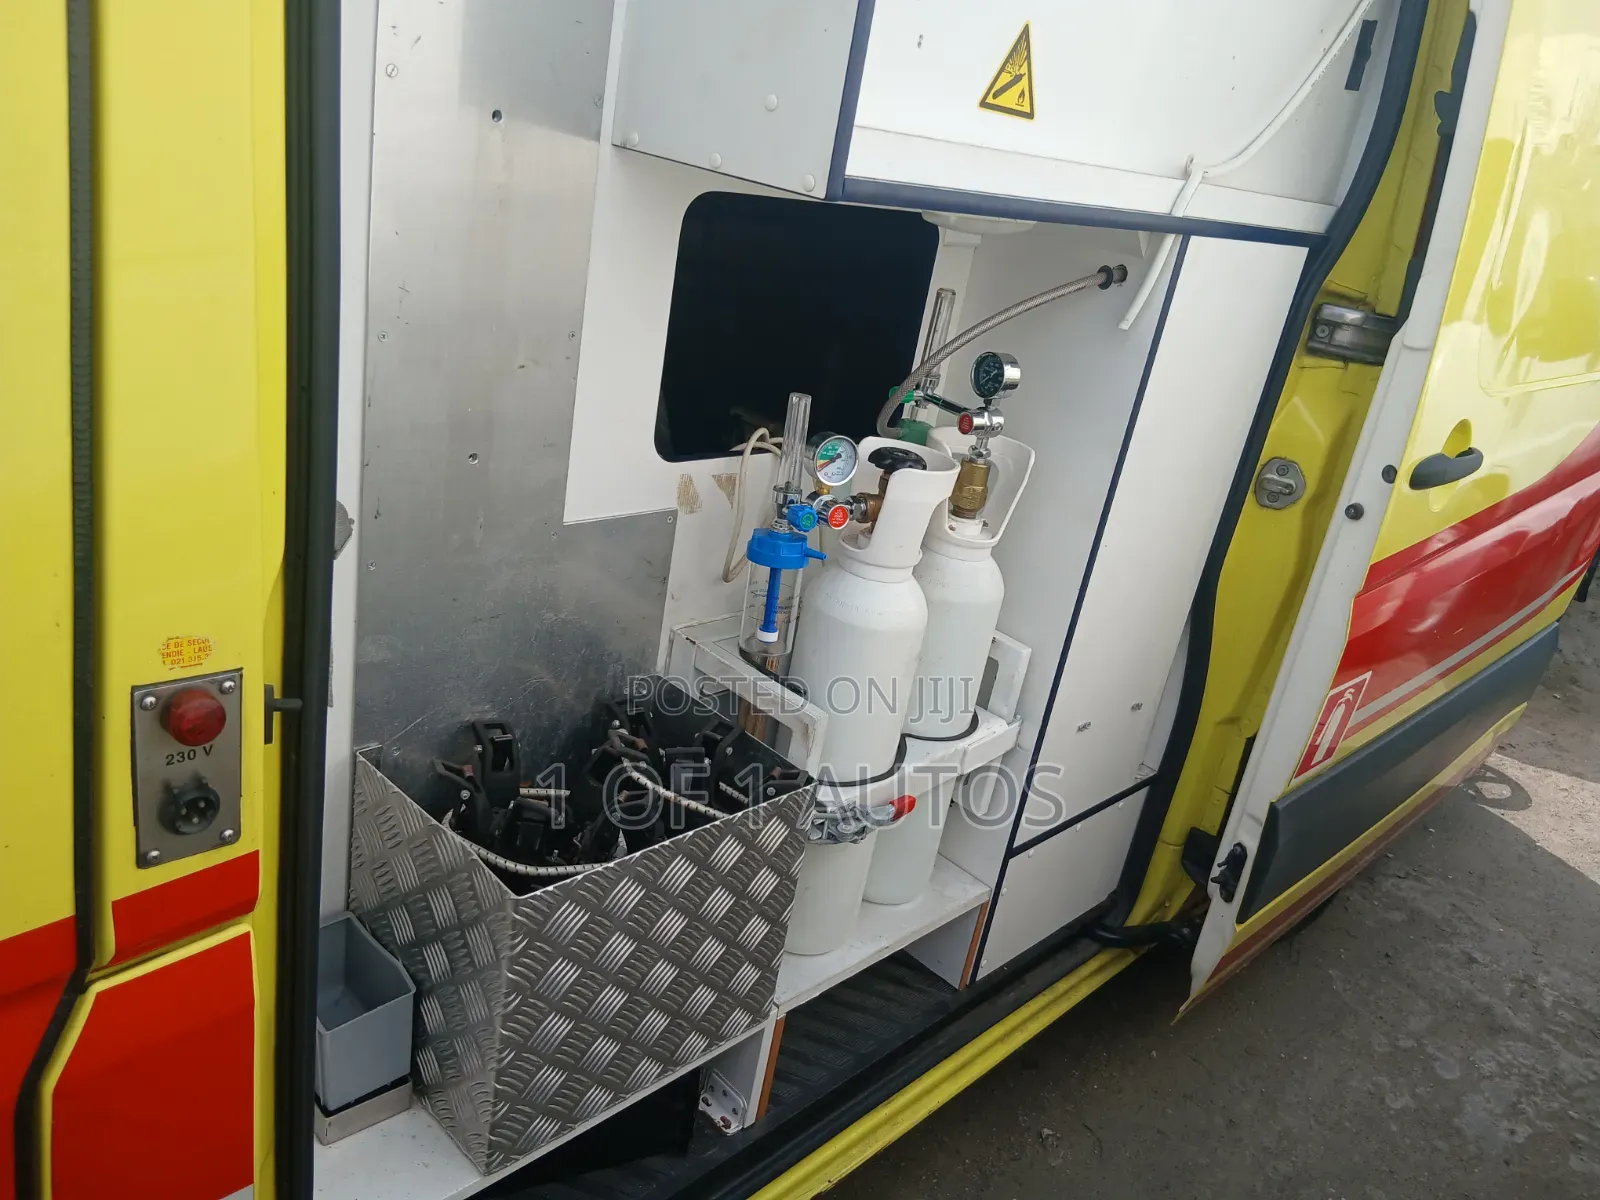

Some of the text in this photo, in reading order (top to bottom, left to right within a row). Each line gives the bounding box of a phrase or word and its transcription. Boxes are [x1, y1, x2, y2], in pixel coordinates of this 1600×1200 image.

[174, 640, 184, 648] DE
[170, 657, 184, 665] 021
[165, 744, 213, 766] 230 V
